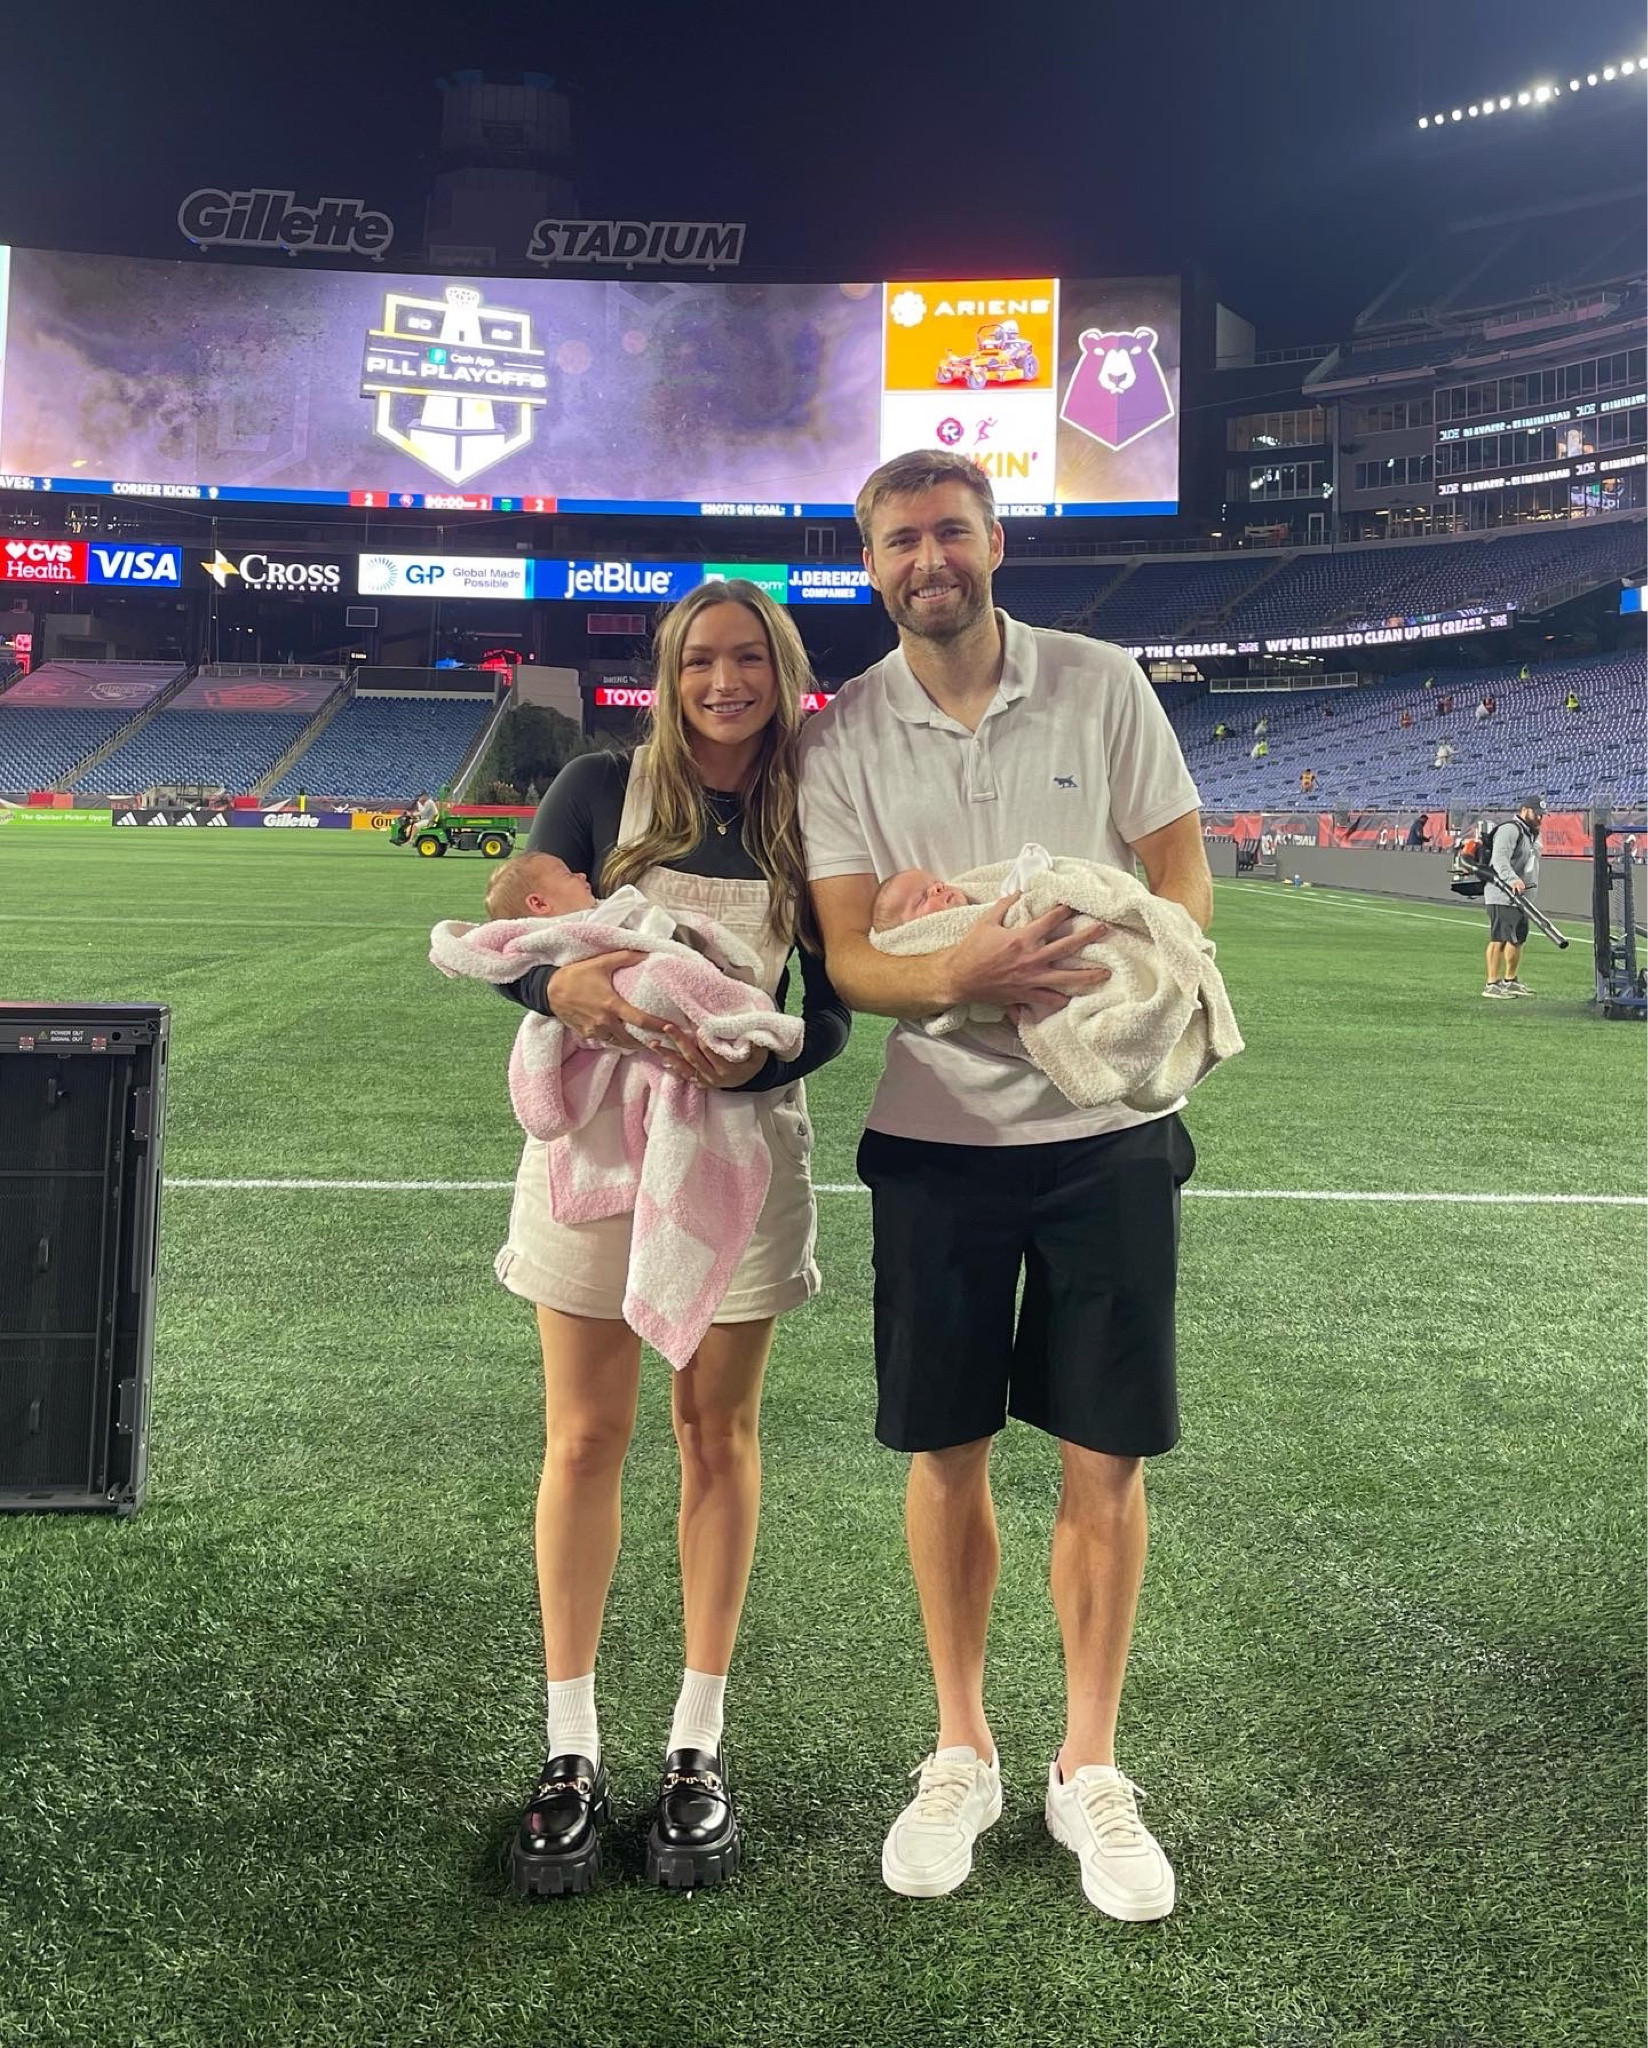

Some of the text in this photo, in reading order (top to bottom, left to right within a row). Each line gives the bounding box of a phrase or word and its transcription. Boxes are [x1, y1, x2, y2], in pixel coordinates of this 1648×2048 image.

[178, 188, 394, 254] Gillette
[526, 219, 746, 264] STADIUM
[934, 299, 1051, 316] ARIENS
[367, 357, 547, 388] PLL PLAYOFFS
[112, 483, 161, 496] CORNER
[701, 505, 736, 516] SHOTS
[27, 544, 72, 561] CVS
[7, 561, 70, 579] Health
[92, 549, 177, 580] VISA
[452, 567, 521, 579] Global Made
[245, 583, 339, 593] INSURANCE
[464, 578, 508, 588] Possible
[564, 562, 673, 599] jetBlue
[802, 588, 856, 598] COMPANIES
[1265, 638, 1308, 652] WE'RE
[1311, 632, 1345, 649] HERE
[1346, 631, 1363, 646] TO
[1364, 626, 1402, 643] CLEAN
[1404, 625, 1421, 640] UP
[1422, 621, 1441, 637] THE
[1145, 645, 1174, 658] THE
[604, 688, 660, 706] TOYO
[21, 813, 33, 821] The
[35, 814, 62, 822] Quicker
[89, 814, 110, 823] Upper
[263, 813, 319, 828] Gillette
